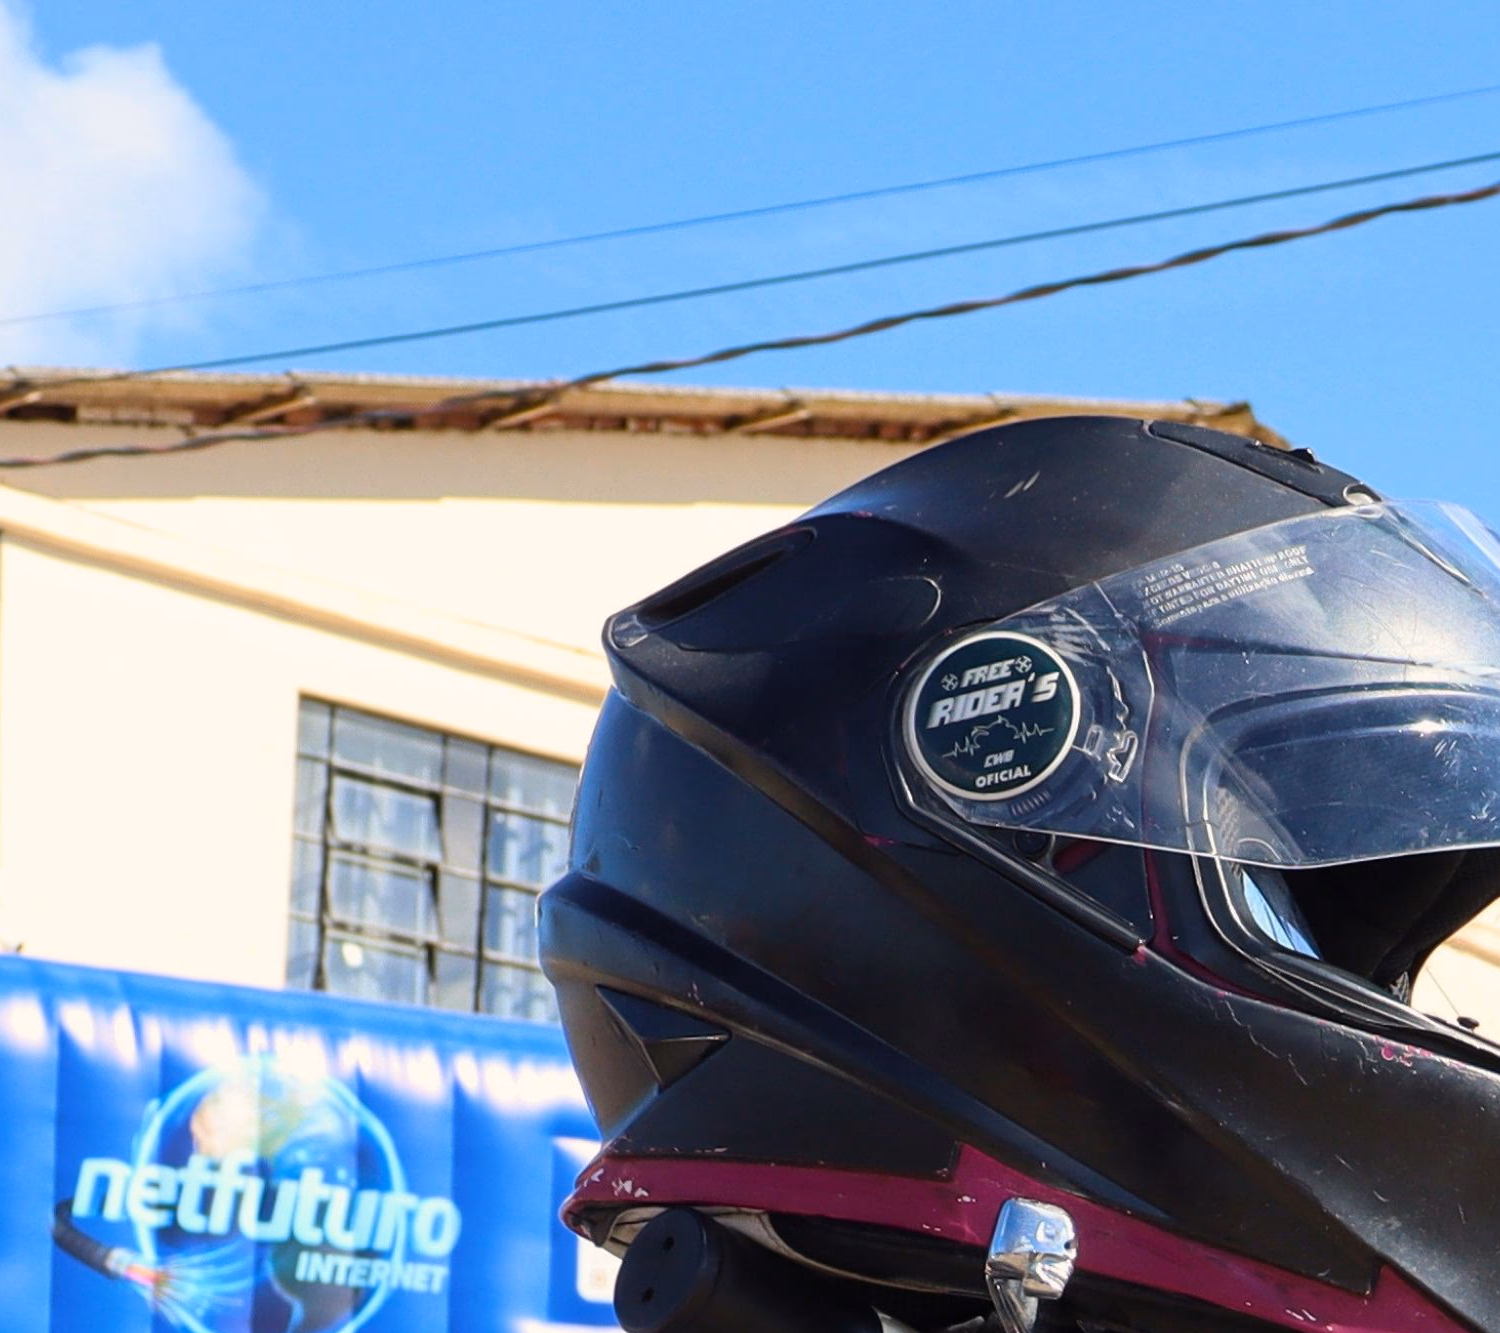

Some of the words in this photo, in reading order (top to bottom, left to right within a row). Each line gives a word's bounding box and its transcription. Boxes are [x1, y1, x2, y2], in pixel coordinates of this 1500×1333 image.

[960, 659, 1015, 688] FREE
[926, 672, 1060, 729] RIDER'S
[975, 764, 1032, 788] OFICIAL
[295, 1251, 449, 1294] INTERNET
